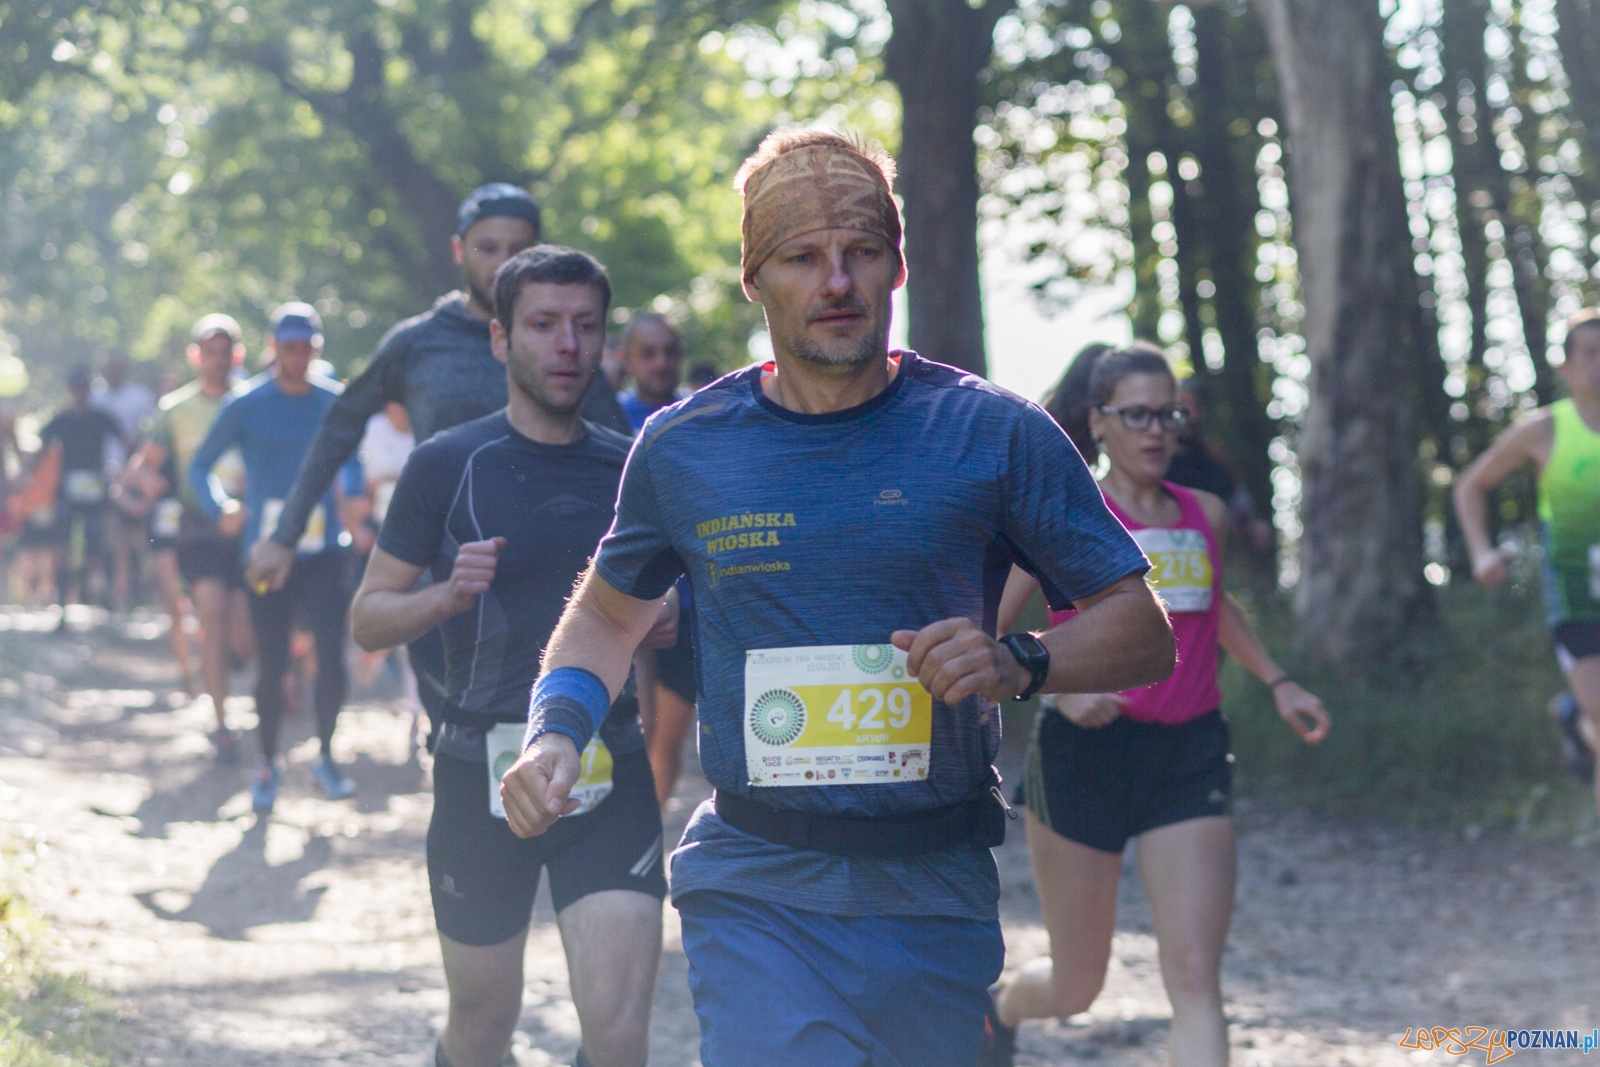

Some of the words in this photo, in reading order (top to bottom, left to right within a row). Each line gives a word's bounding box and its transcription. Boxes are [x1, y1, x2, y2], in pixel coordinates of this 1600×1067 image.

[696, 511, 797, 539] INDIAŃSKA
[707, 531, 780, 555] WIOSKA
[826, 688, 912, 731] 429
[855, 734, 890, 743] ARTUR
